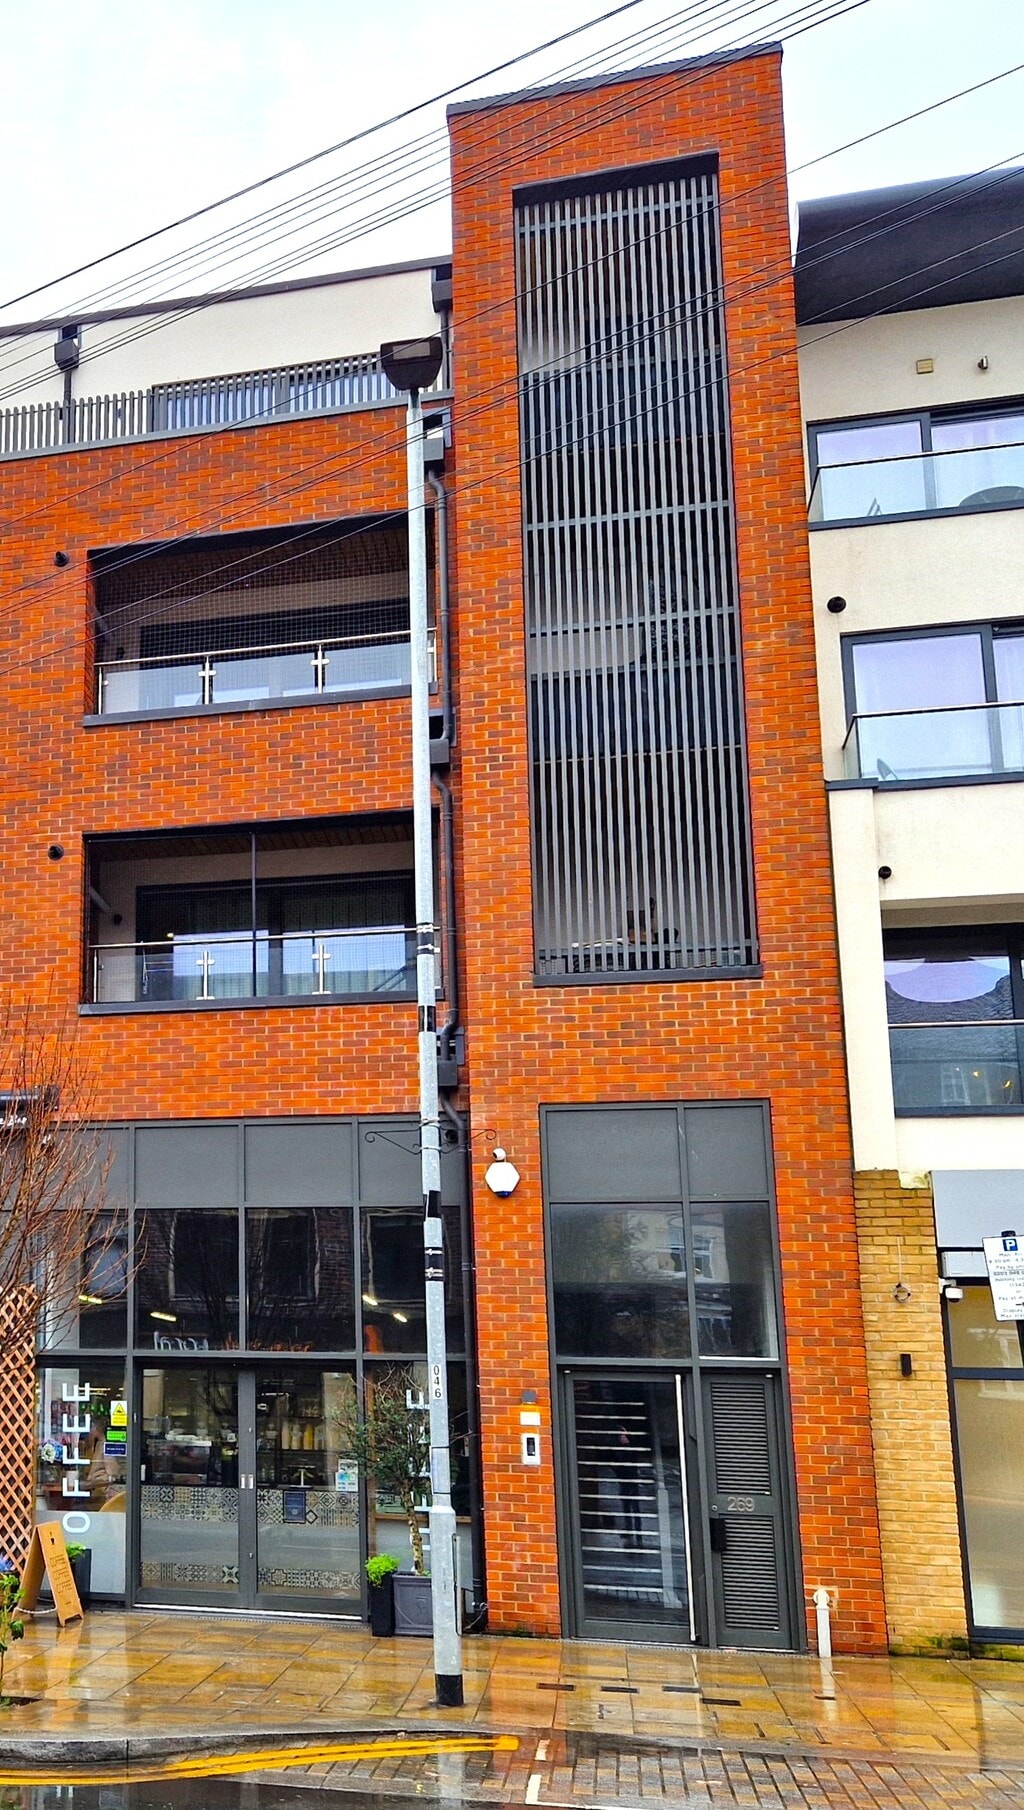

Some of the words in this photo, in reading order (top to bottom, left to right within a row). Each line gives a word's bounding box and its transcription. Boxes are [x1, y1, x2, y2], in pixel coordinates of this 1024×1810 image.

[1005, 1239, 1016, 1251] P
[62, 1382, 91, 1534] OFFEE
[727, 1496, 755, 1512] 269
